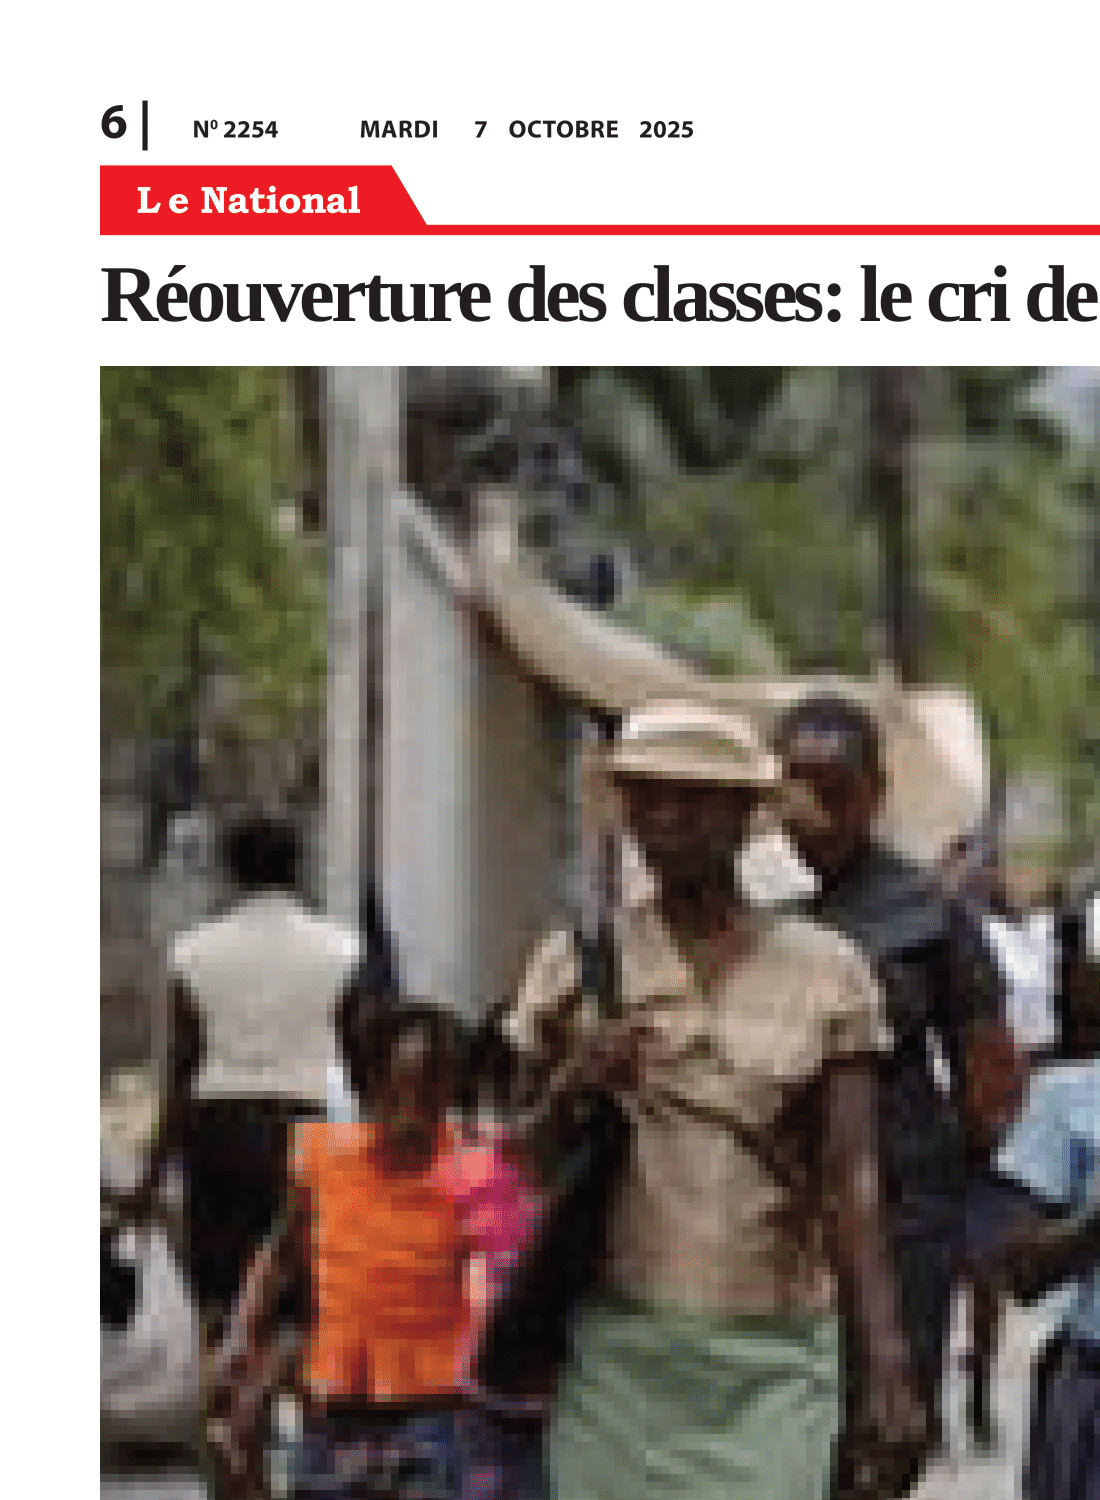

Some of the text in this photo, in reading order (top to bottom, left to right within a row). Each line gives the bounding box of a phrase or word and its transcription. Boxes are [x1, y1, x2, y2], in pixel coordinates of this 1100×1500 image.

[101, 104, 127, 139] 6
[223, 120, 279, 139] 2254
[360, 119, 694, 139] MARDI 7 OCTOBRE 2025
[201, 185, 361, 214] National
[101, 265, 491, 322] Réouverture
[508, 265, 606, 322] des
[624, 265, 841, 322] classes:
[861, 265, 912, 322] le
[929, 265, 1010, 322] cri
[1027, 265, 1098, 322] de
